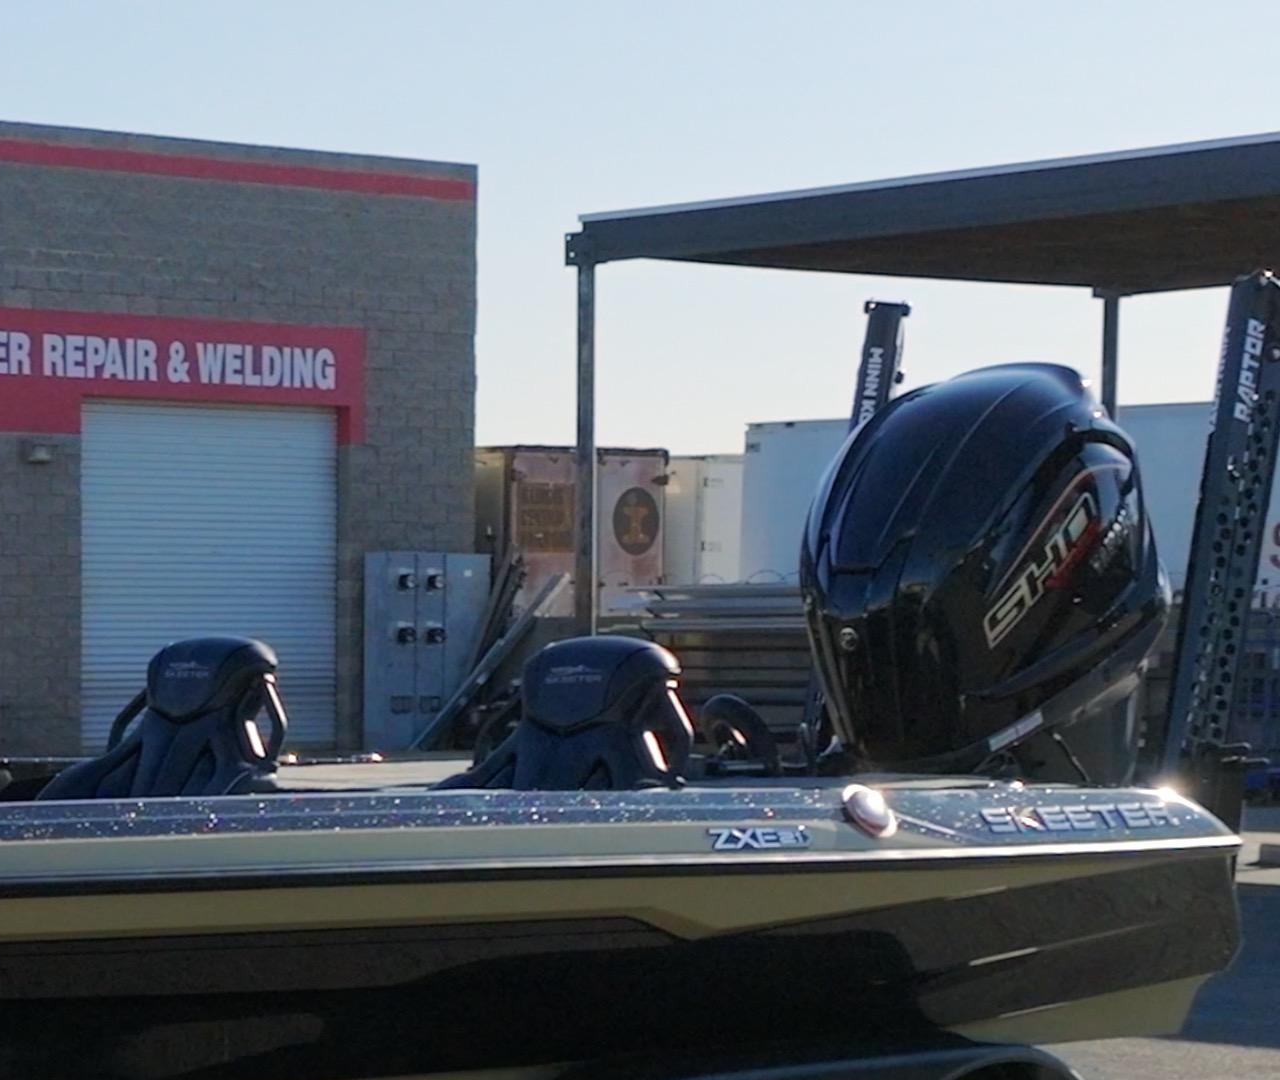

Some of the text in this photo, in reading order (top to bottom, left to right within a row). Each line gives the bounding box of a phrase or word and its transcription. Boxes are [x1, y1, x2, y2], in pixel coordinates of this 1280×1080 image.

[42, 333, 158, 382] REPAIR
[166, 341, 191, 384] &
[197, 343, 337, 391] WELDING
[862, 346, 884, 397] MINN
[1234, 317, 1266, 424] RAPTOR
[980, 802, 1173, 834] SKEETER
